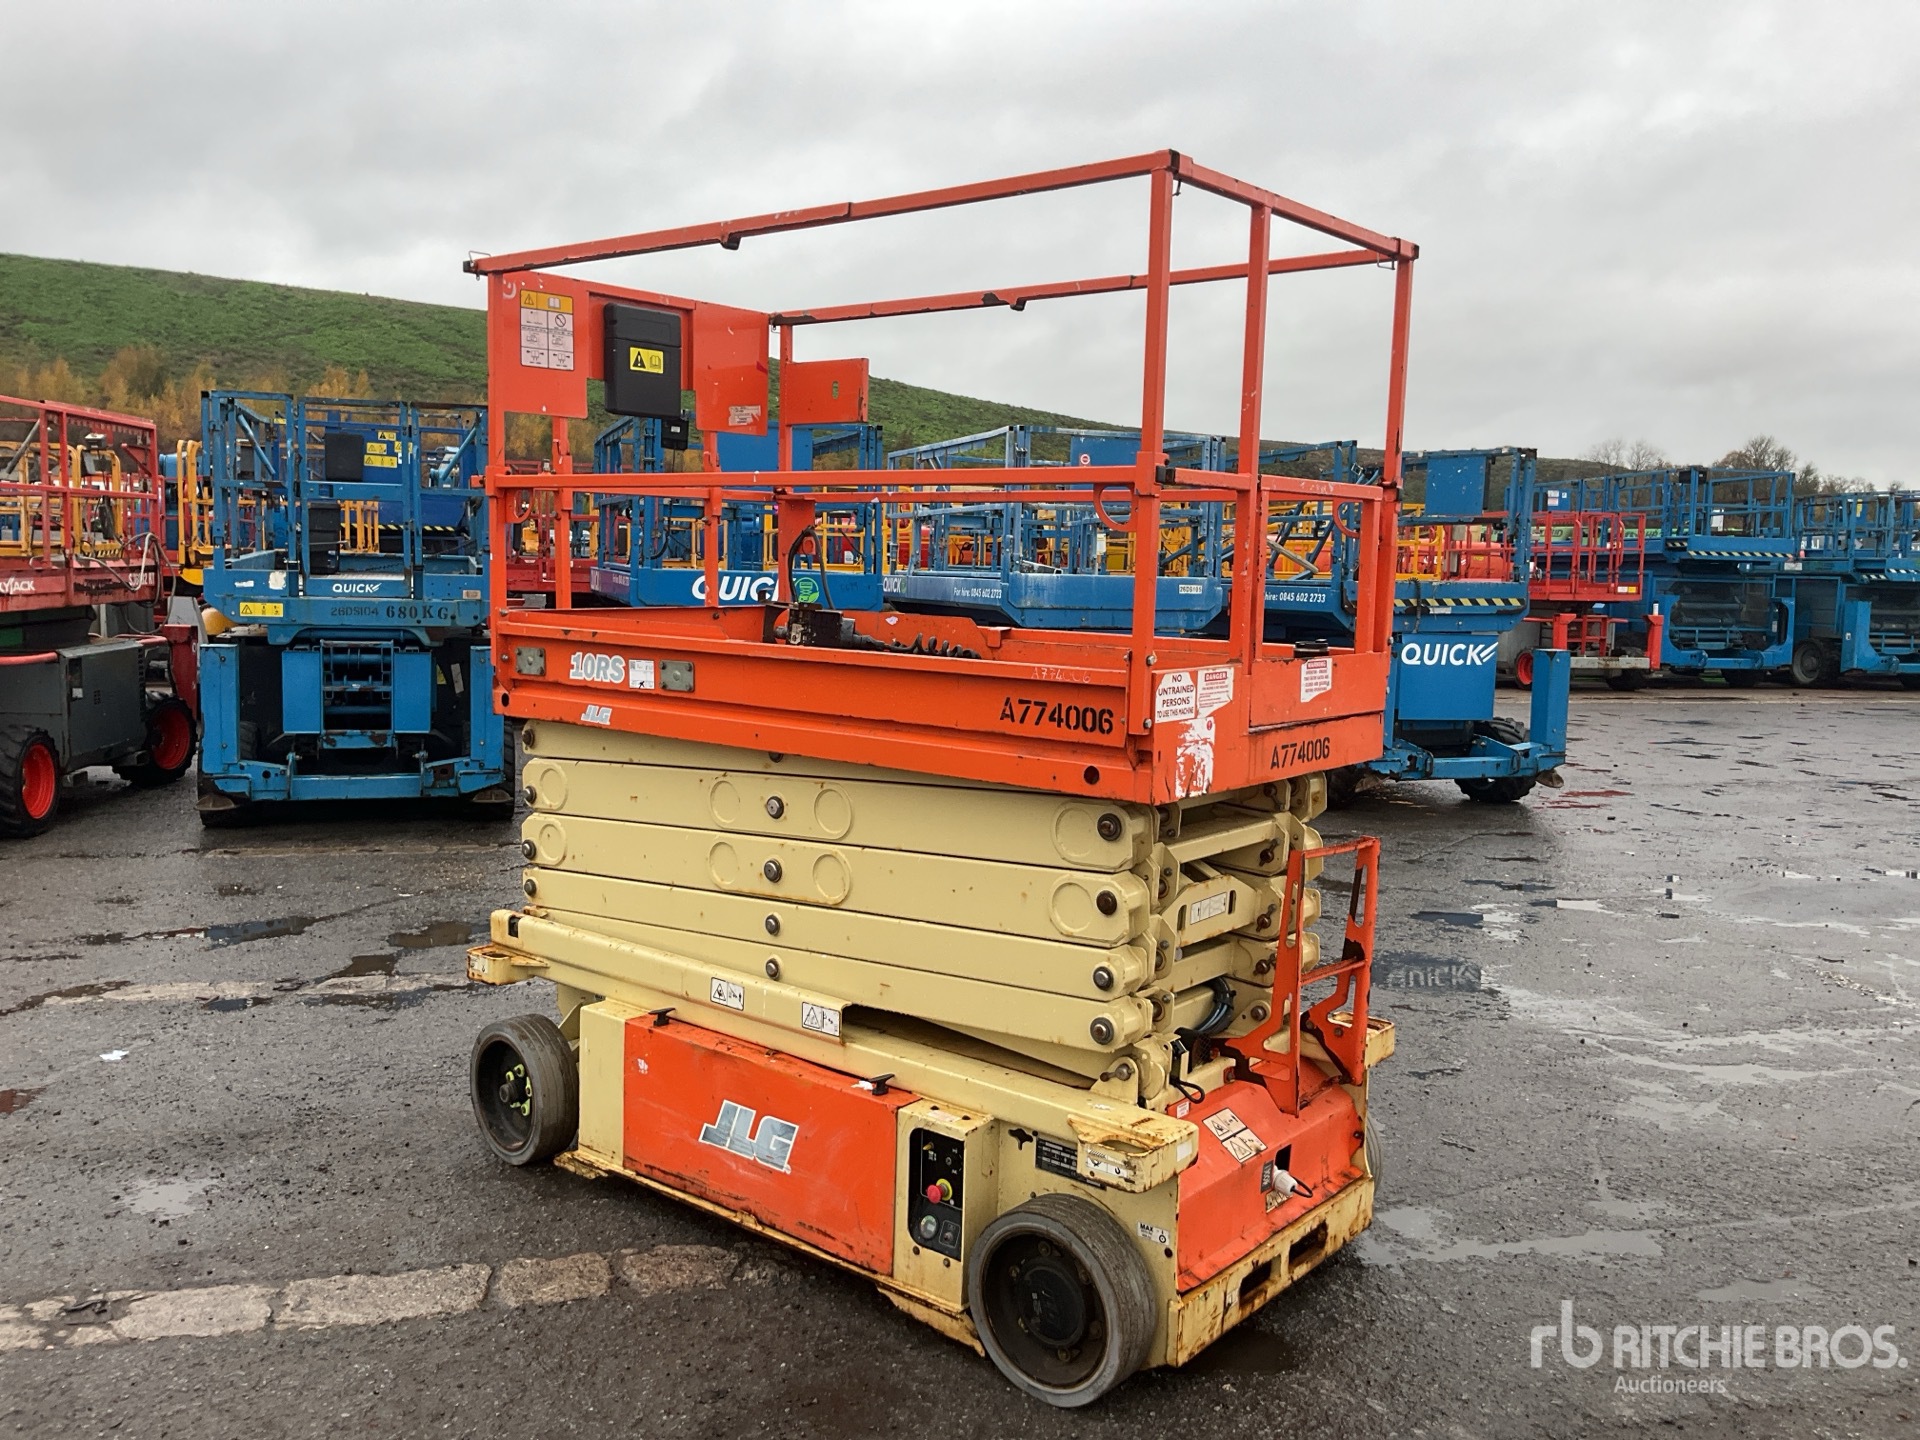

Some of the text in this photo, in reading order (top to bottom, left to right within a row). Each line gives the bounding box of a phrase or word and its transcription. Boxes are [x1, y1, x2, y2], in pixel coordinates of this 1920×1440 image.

[332, 583, 378, 593] QUICK
[1279, 591, 1294, 601] 0845
[1295, 592, 1308, 602] 602
[1309, 593, 1326, 603] 2733
[1401, 642, 1490, 666] QUICK
[569, 652, 626, 684] 10RS
[1171, 674, 1183, 683] NO
[1205, 672, 1227, 681] DANGER
[1157, 684, 1195, 697] UNTRAINED
[1161, 696, 1191, 708] PERSONS
[581, 704, 613, 726] JLG
[999, 696, 1115, 735] A774006
[1156, 706, 1194, 719] TO USE THIS MACHINE
[1269, 736, 1331, 770] A774006
[698, 1099, 800, 1173] JLG
[1140, 1222, 1154, 1232] MAX
